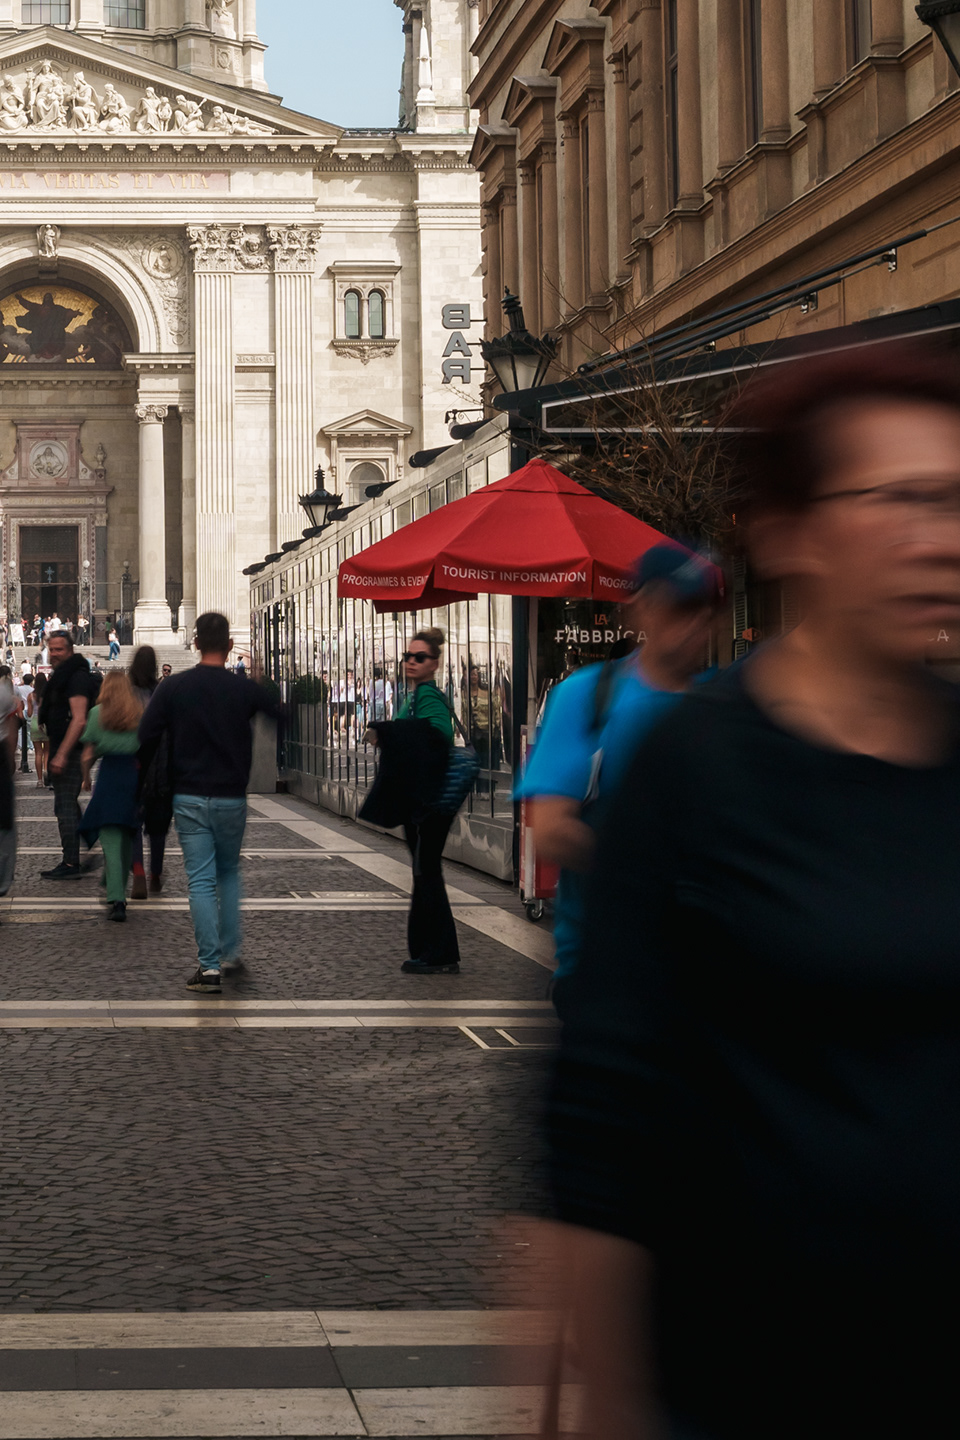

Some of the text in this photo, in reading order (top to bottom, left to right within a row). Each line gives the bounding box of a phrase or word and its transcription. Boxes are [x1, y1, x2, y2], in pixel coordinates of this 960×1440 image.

[42, 173, 120, 189] VERITAS
[132, 173, 155, 189] ET
[168, 173, 210, 189] VITA
[342, 573, 399, 587] PROGRAMMES
[400, 576, 407, 587] &
[442, 565, 586, 583] TOURIST INFORMATION
[594, 614, 608, 625] LA
